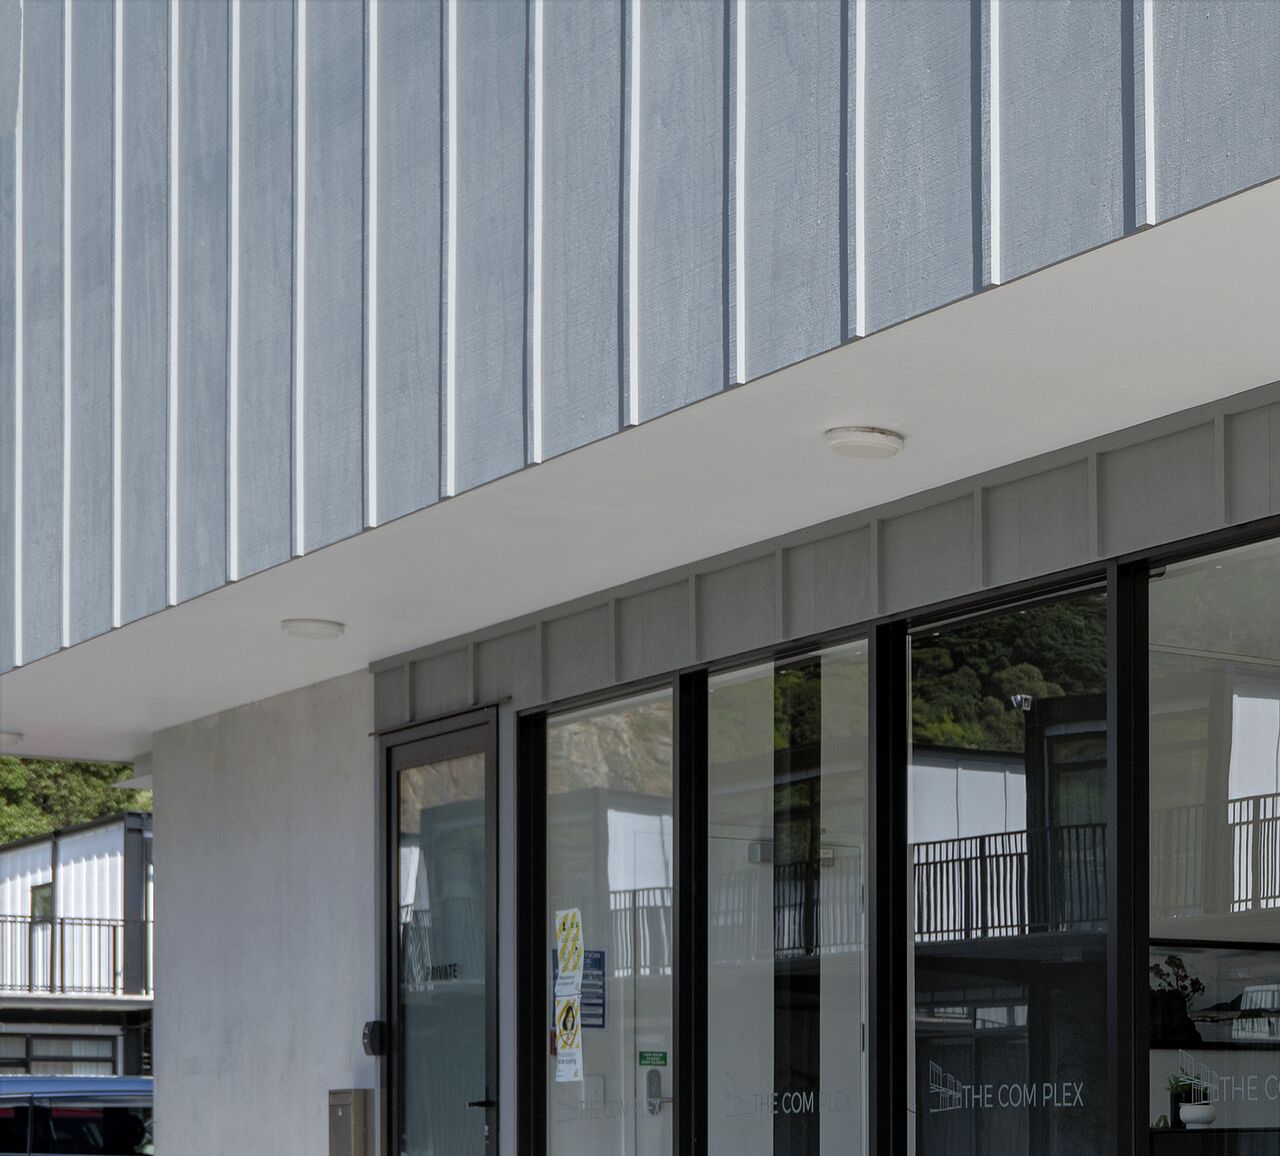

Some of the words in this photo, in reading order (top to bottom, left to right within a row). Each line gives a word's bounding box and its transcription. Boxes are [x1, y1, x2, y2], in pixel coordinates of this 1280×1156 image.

[426, 963, 457, 980] PRIVATE
[962, 1084, 994, 1108] THE
[998, 1083, 1037, 1108] COM
[1042, 1082, 1084, 1107] PLEX
[1219, 1075, 1259, 1102] THE
[782, 1091, 814, 1113] COM
